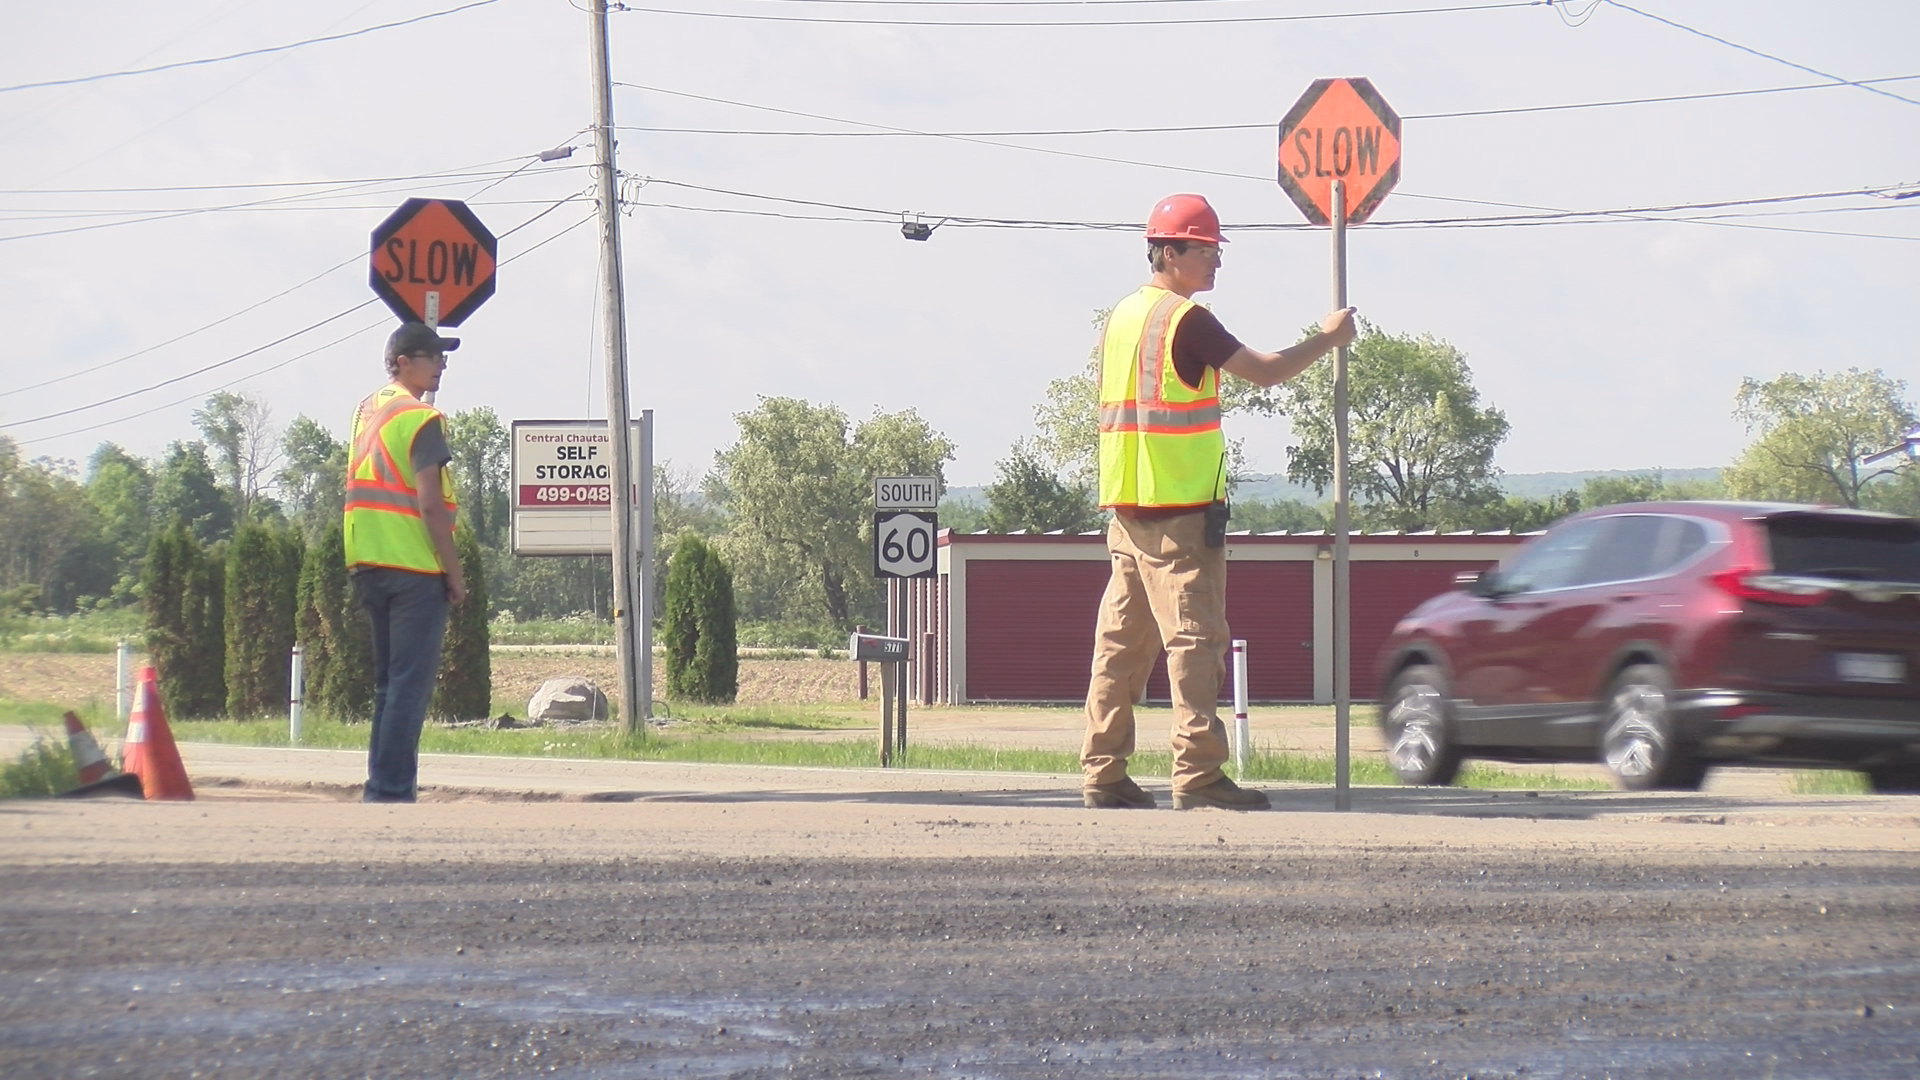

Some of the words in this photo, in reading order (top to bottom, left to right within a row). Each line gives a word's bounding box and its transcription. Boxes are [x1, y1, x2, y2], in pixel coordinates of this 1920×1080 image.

[1293, 125, 1382, 179] SLOW
[384, 237, 479, 287] SLOW
[525, 434, 563, 442] Central
[566, 434, 609, 442] Chautau
[557, 446, 597, 460] SELF
[536, 465, 610, 479] STORAG
[537, 487, 609, 501] 499-048
[881, 484, 932, 501] SOUTH
[882, 527, 930, 563] 60
[1228, 549, 1233, 557] 7
